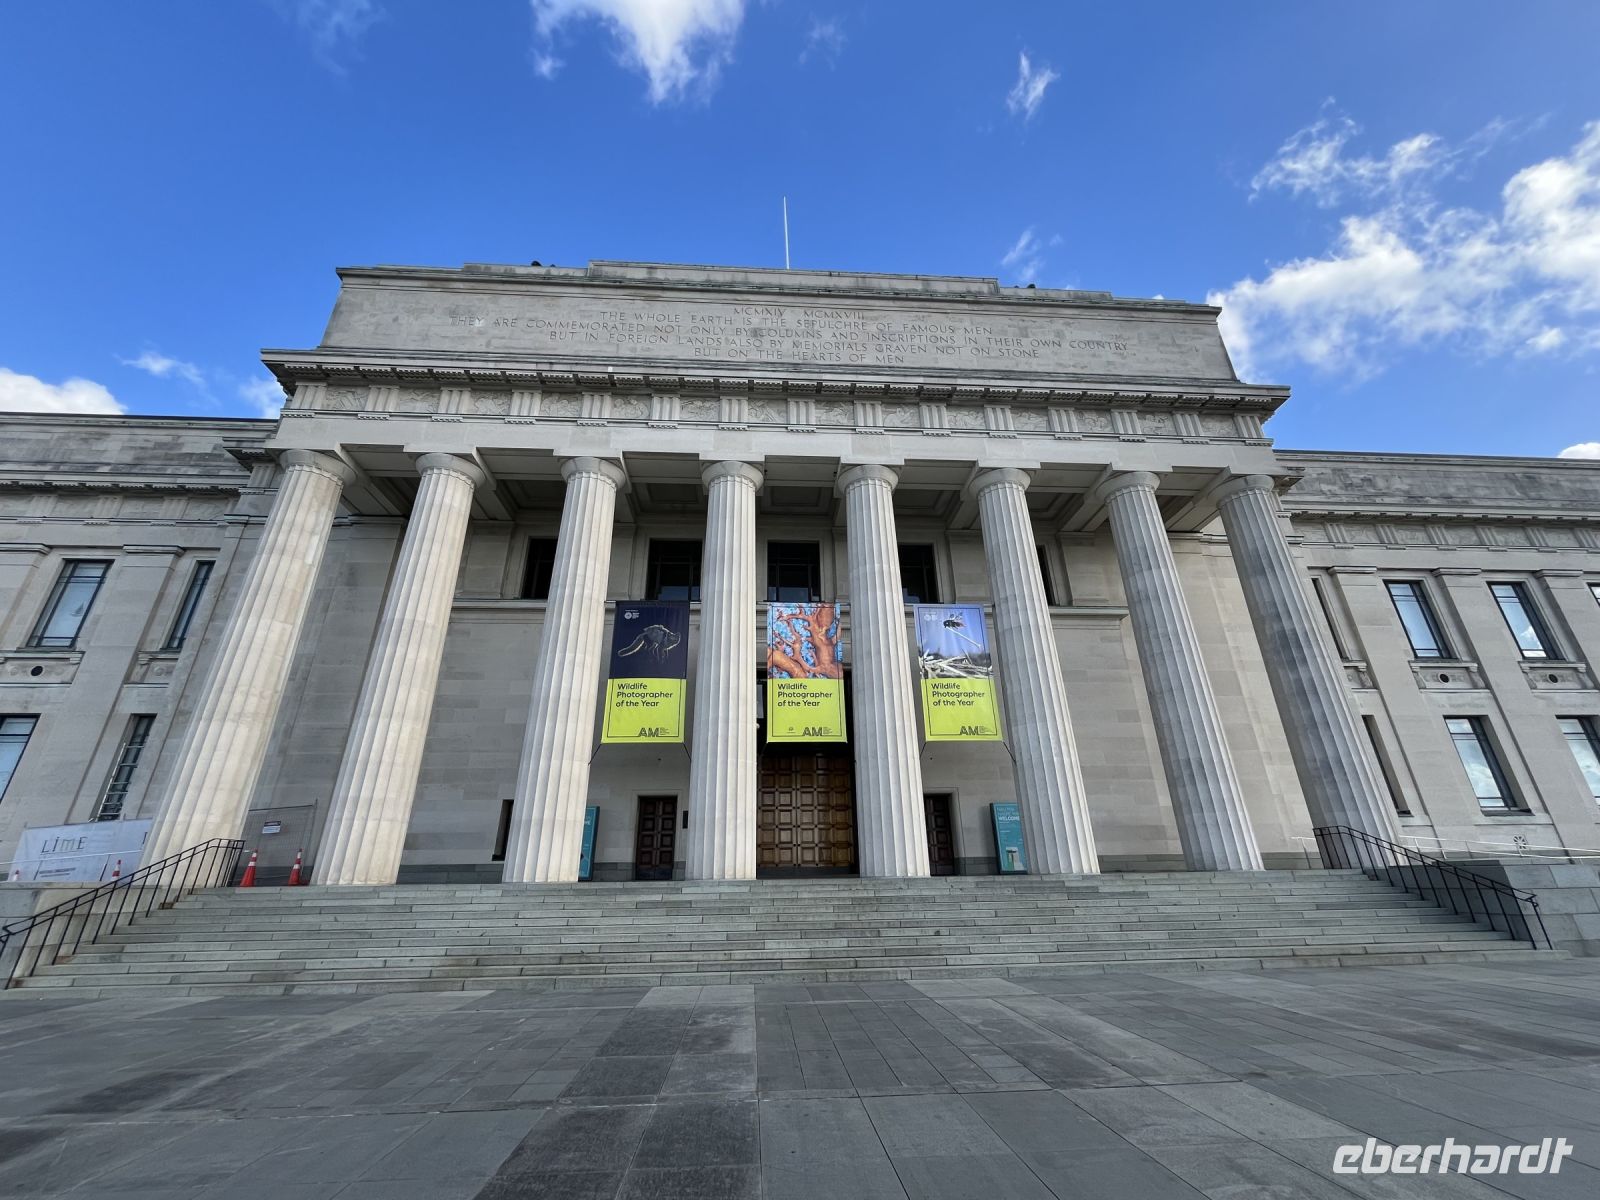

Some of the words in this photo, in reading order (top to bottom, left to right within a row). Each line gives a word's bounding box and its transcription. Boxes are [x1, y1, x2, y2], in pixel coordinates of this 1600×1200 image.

[733, 307, 787, 317] MCMXIV
[803, 310, 865, 320] MCMXVIII
[600, 312, 626, 321] THE
[634, 313, 681, 322] WHOLE
[691, 315, 733, 325] EARTH
[743, 318, 752, 326] IS
[762, 318, 787, 327] THE
[797, 320, 868, 331] SEPULCHRE
[876, 322, 893, 331] OF
[903, 323, 955, 334] FAMOUS
[964, 327, 992, 335] MEN
[449, 316, 485, 326] THEY
[494, 318, 518, 328] ARE
[526, 319, 645, 332] COMMEMORATED
[654, 325, 683, 334] NOT
[690, 326, 726, 335] ONLY
[736, 327, 750, 336] BY
[758, 329, 822, 340] COLUMNS
[831, 331, 859, 341] AND
[867, 333, 956, 345] INSCRIPTIONS
[964, 336, 978, 345] IN
[987, 337, 1024, 347] THEIR
[1030, 339, 1062, 348] OWN
[1070, 340, 1128, 351] COUNTRY
[550, 331, 576, 340] BUT
[585, 332, 599, 341] IN
[608, 333, 668, 344] FOREIGN
[678, 336, 722, 346] LANDS
[730, 338, 762, 348] ALSO
[770, 339, 784, 348] BY
[792, 340, 867, 352] MEMORIALS
[875, 343, 927, 353] GRAVEN
[936, 346, 963, 355] NOT
[970, 348, 990, 356] ON
[999, 348, 1039, 358] STONE
[694, 348, 720, 357] BUT
[728, 349, 748, 358] ON
[758, 350, 783, 359] THE
[792, 352, 841, 362] HEARTS
[850, 353, 866, 362] OF
[876, 355, 905, 364] MEN
[616, 691, 673, 699] Photographer
[777, 691, 833, 699] Photographer
[639, 727, 660, 737] AM
[802, 727, 823, 736] AM
[960, 726, 979, 735] AM
